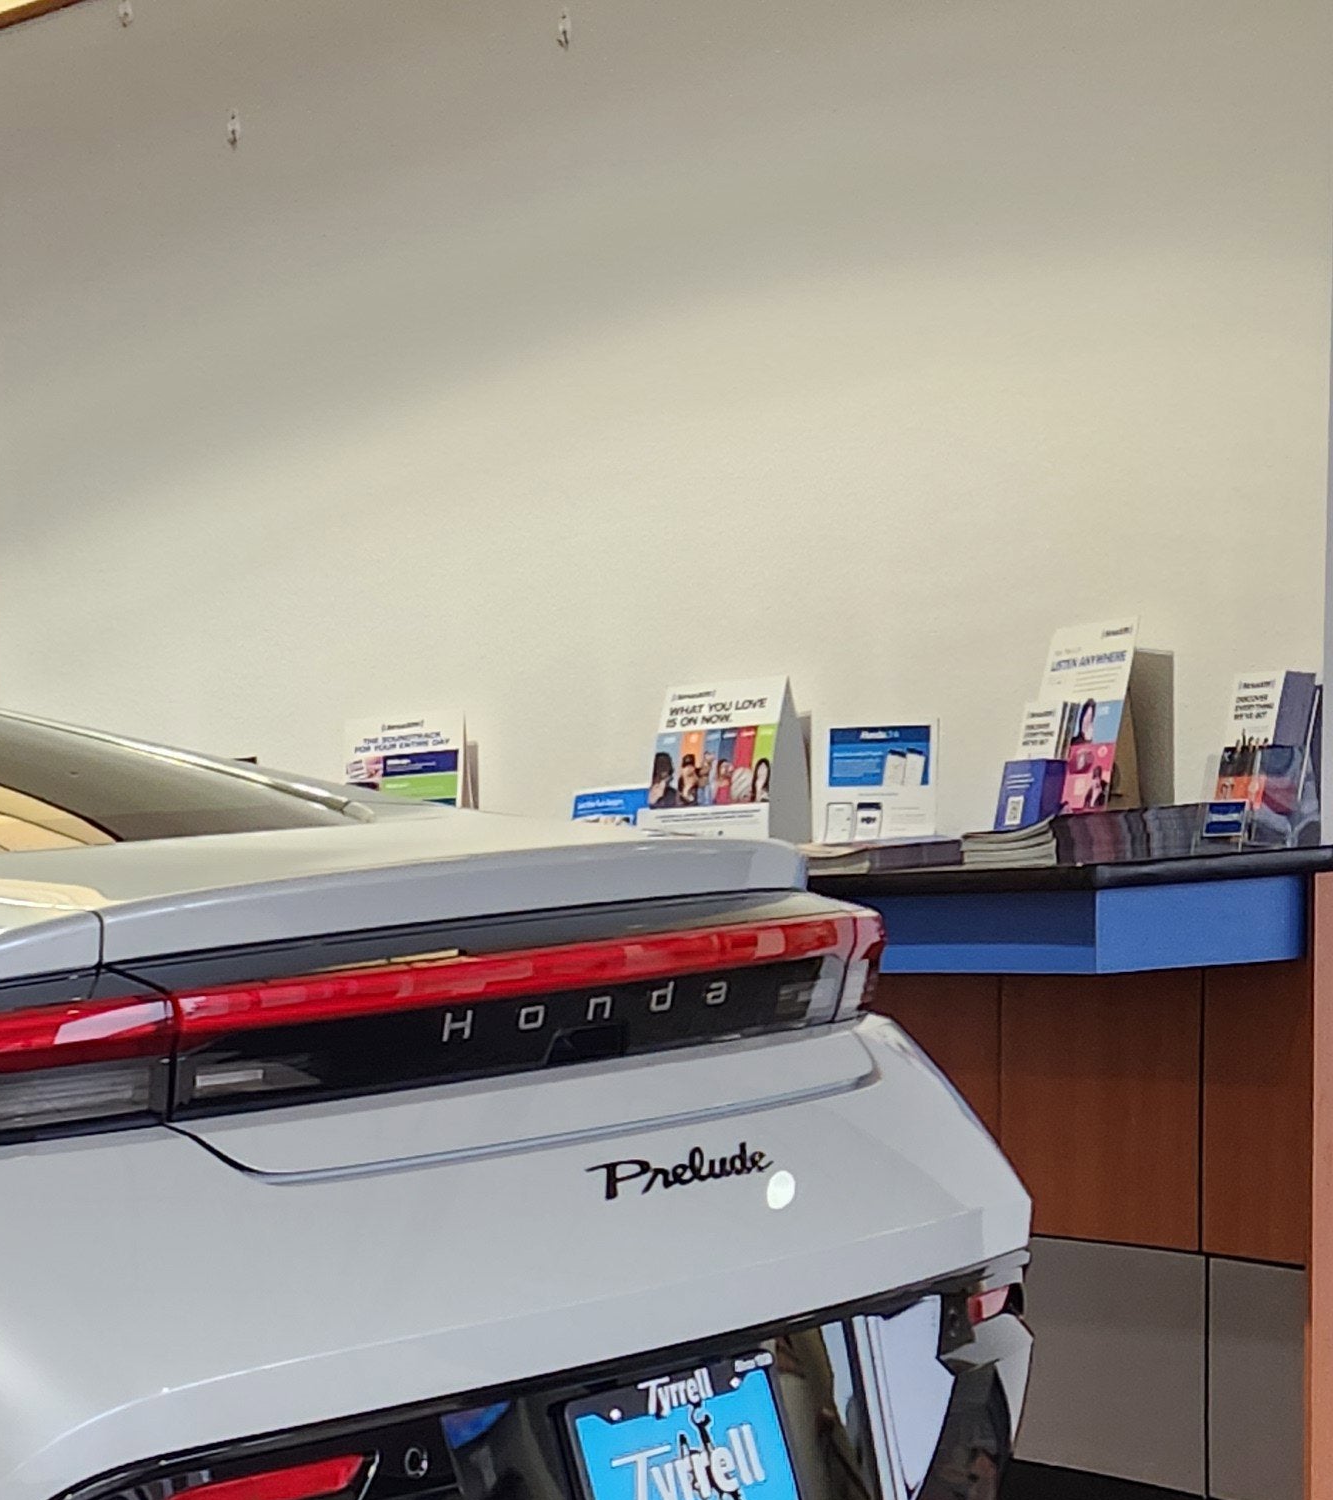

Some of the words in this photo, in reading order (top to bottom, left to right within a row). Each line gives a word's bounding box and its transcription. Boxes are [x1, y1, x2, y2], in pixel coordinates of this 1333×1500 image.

[666, 717, 677, 728] IS
[680, 716, 698, 727] ON
[669, 703, 704, 717] WHAT
[708, 701, 733, 713] YOU
[735, 698, 768, 711] LOVE
[440, 979, 730, 1043] Honda
[585, 1141, 774, 1201] Prelude
[637, 1367, 714, 1417] Tyrrell
